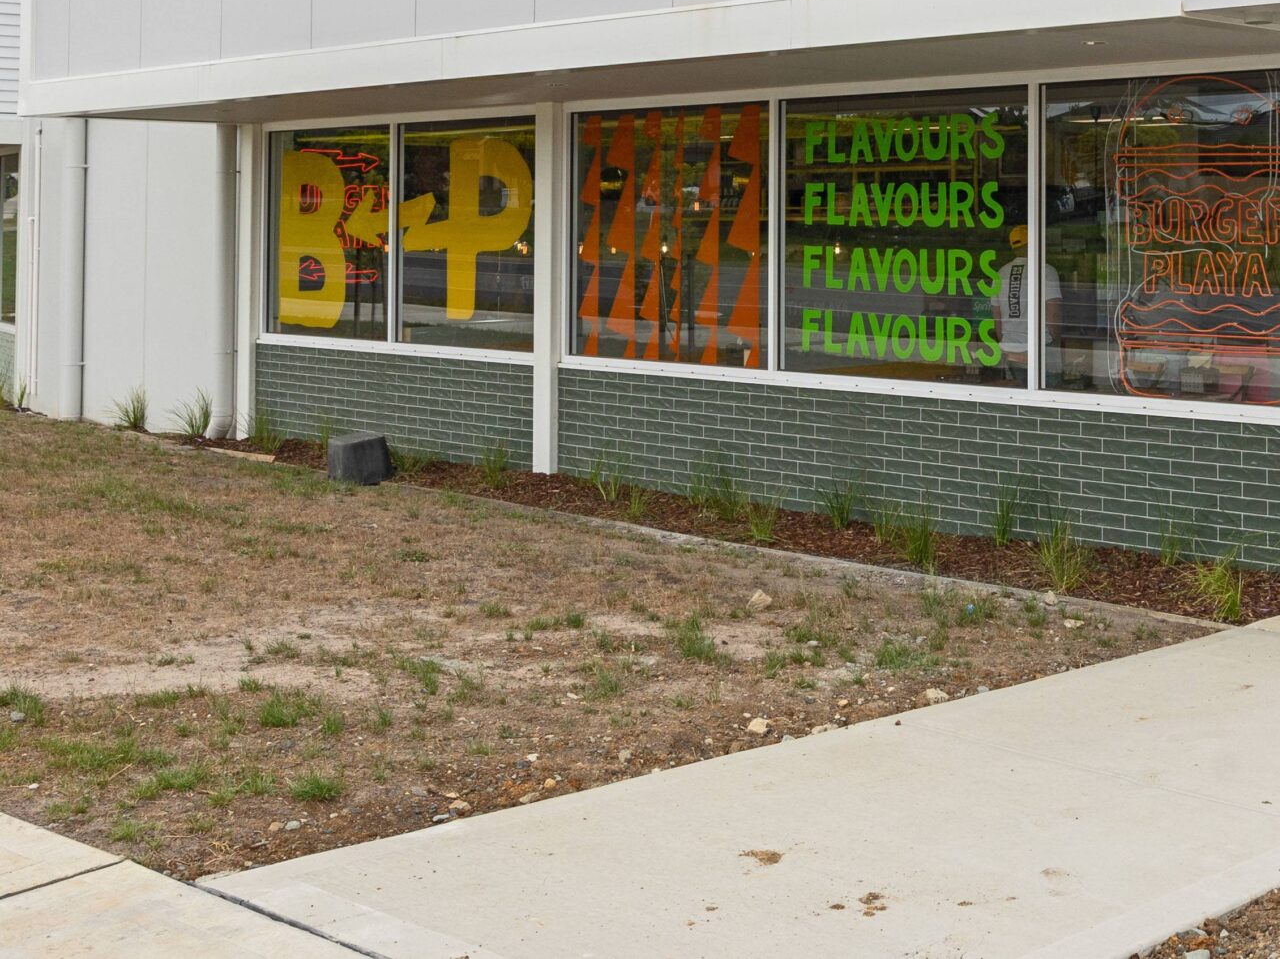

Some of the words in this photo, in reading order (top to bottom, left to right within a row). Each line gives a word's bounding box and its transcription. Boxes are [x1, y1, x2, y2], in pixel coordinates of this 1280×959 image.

[804, 110, 1006, 164] FLAVOURS
[804, 181, 1005, 229] FLAVOURS
[802, 245, 1003, 297] FLAVOURS
[1009, 274, 1021, 317] CHICAGO
[1143, 251, 1274, 297] PLAYA
[801, 308, 1002, 367] FLAVOURS
